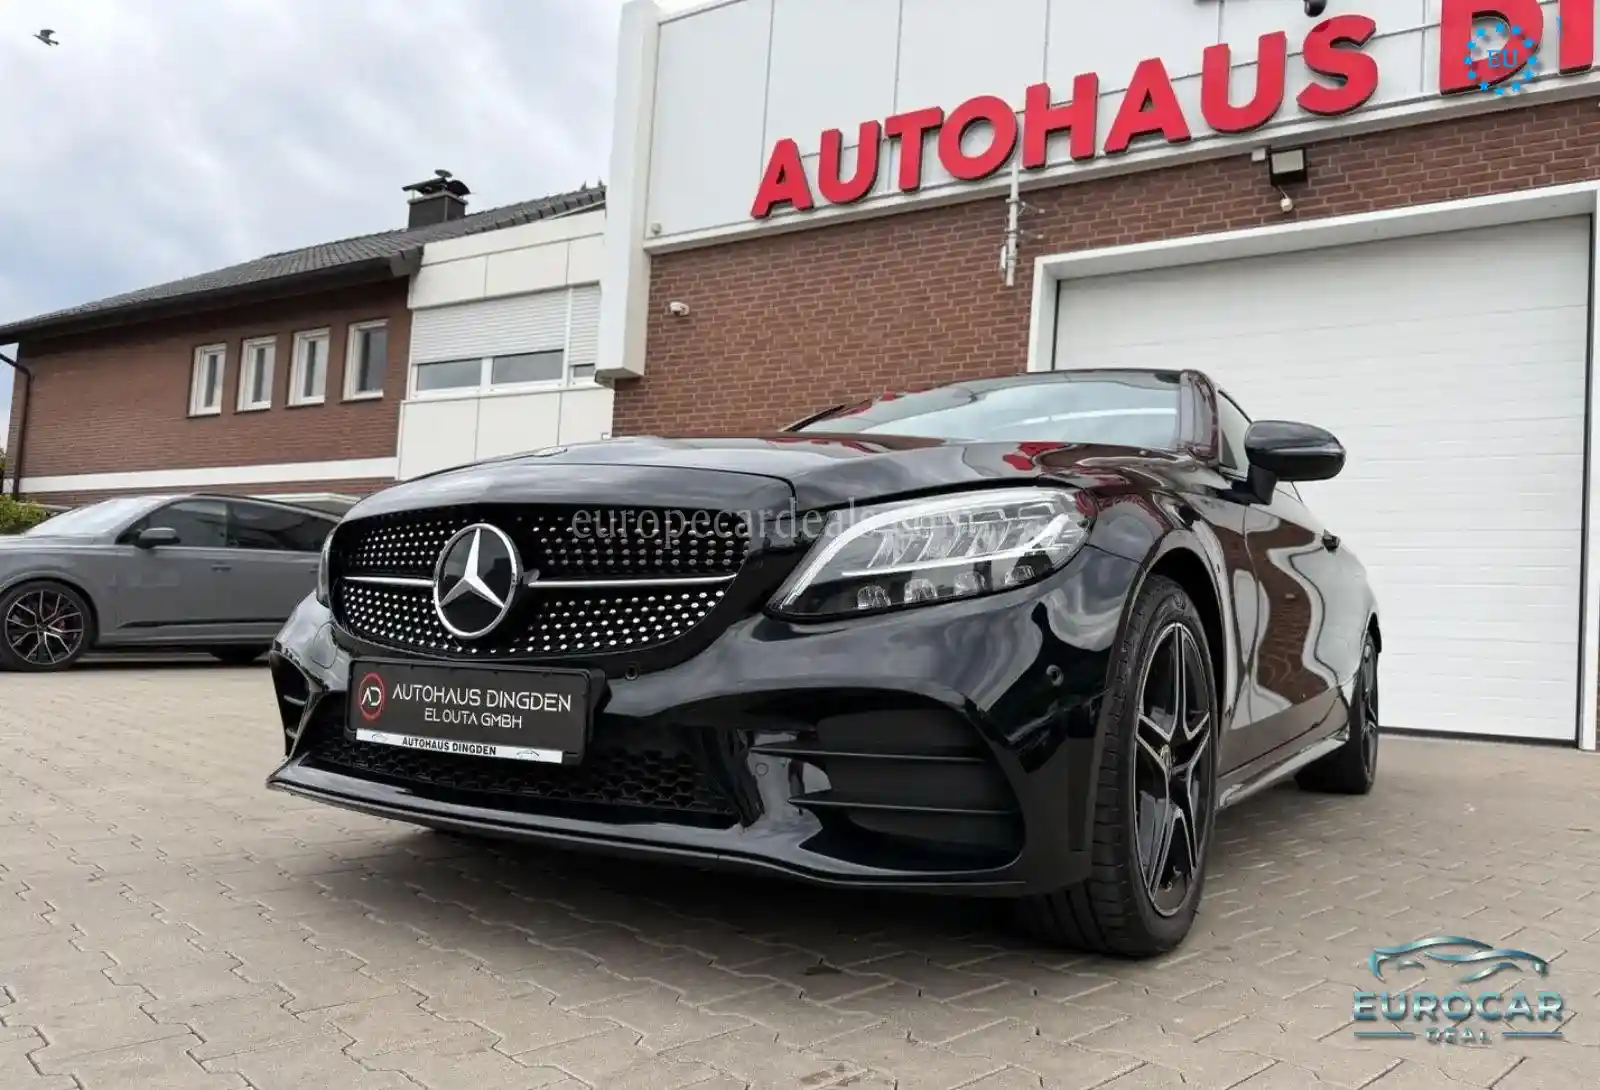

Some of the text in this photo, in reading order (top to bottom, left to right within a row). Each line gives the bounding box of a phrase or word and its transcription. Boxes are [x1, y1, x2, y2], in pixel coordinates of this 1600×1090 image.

[751, 14, 1379, 219] AUTOHAUS
[392, 683, 572, 712] AUTOHAUS DINGDEN
[424, 707, 523, 729] EL OUTA GMBH
[402, 736, 497, 756] AUTOHAUS DINGDEN
